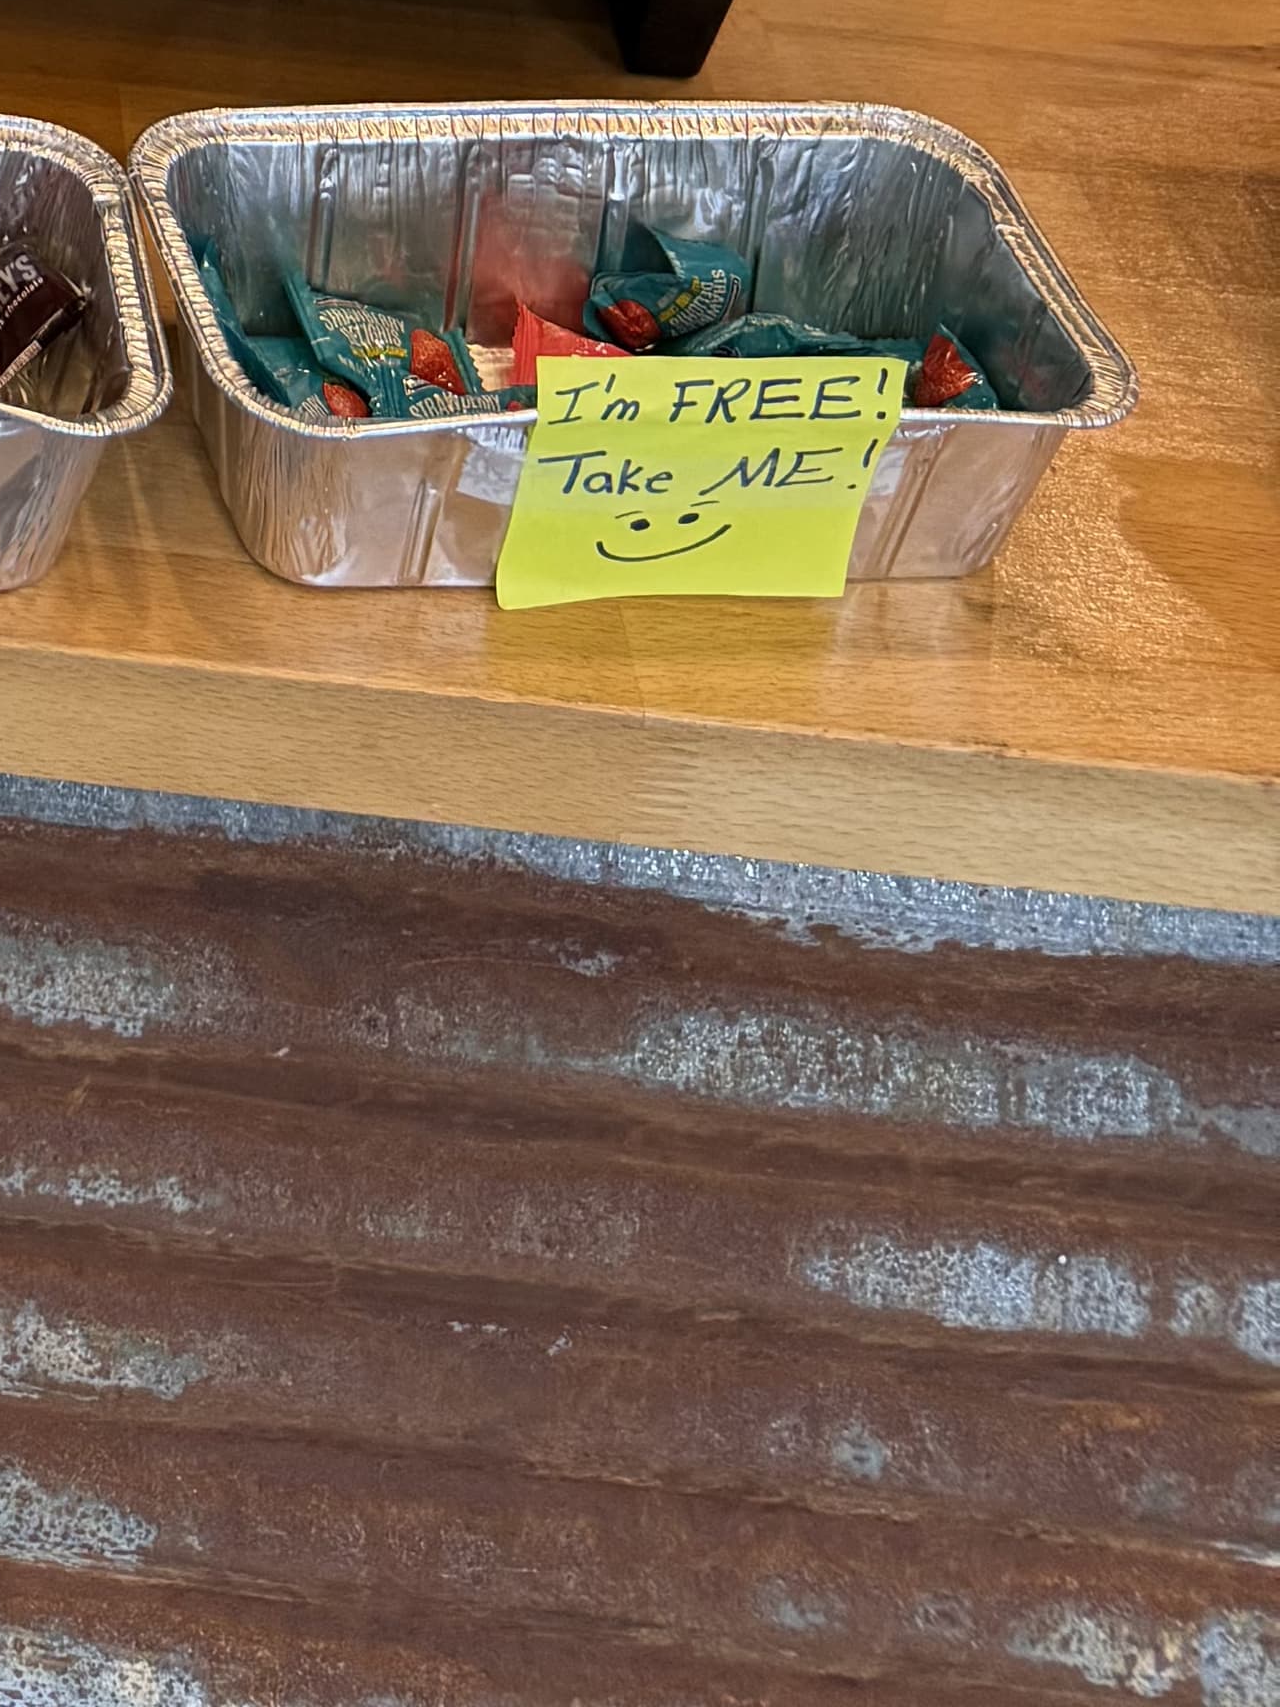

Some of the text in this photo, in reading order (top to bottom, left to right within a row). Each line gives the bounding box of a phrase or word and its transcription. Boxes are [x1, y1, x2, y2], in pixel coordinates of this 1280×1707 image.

[547, 367, 890, 429] I'm FREE!
[537, 437, 880, 498] Take ME!
